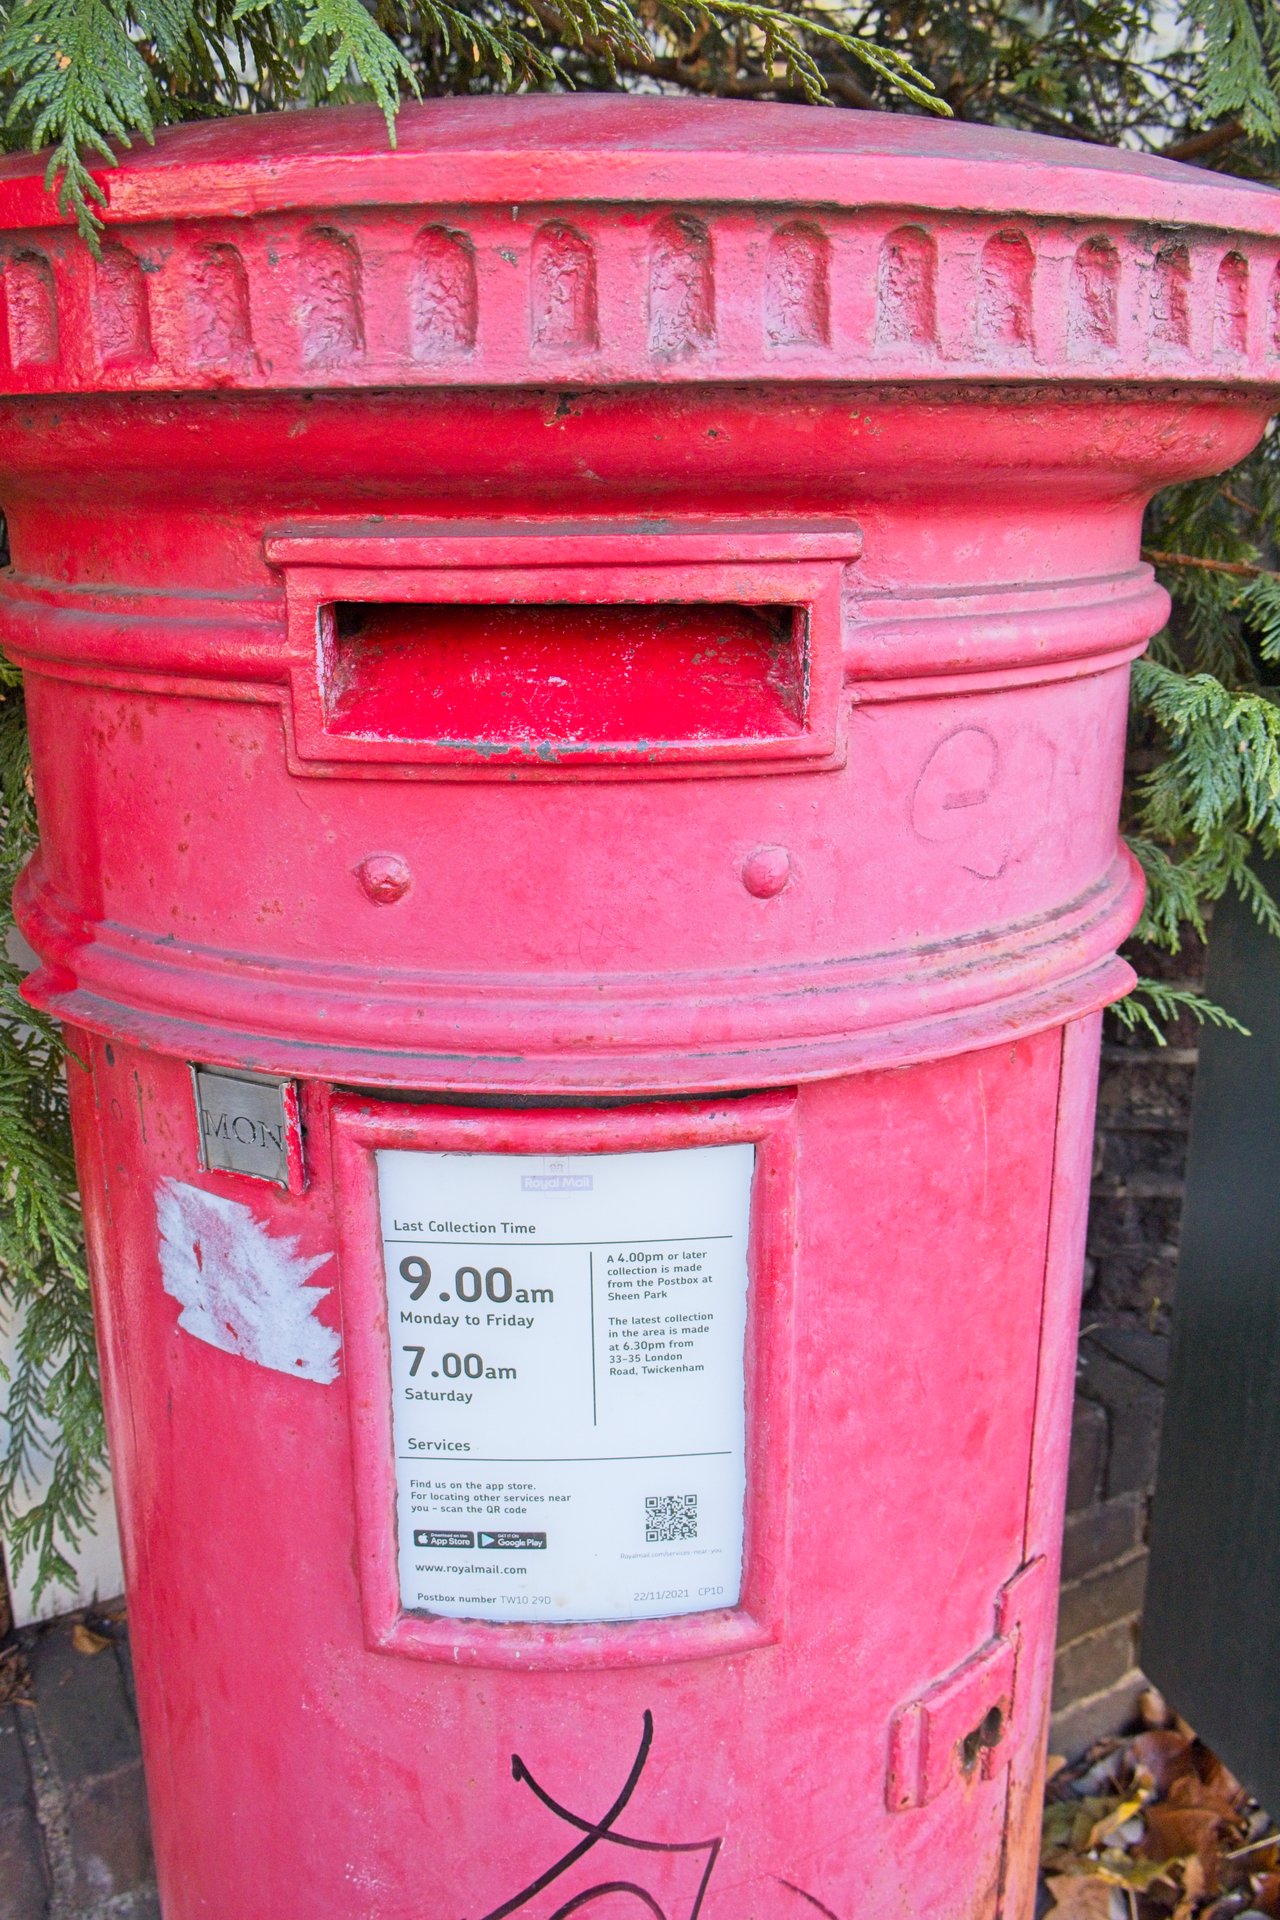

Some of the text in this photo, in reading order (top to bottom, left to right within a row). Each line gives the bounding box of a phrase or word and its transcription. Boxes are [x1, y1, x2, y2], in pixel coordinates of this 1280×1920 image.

[202, 1110, 283, 1151] MON
[525, 1177, 589, 1189] Royal Mail
[394, 1220, 536, 1234] Last Collection Time
[607, 1255, 614, 1263] A
[618, 1252, 663, 1263] 4.00pm
[683, 1251, 707, 1260] later
[608, 1264, 702, 1276] collection is made
[399, 1256, 554, 1303] 9.00am
[608, 1280, 632, 1288] from
[658, 1276, 698, 1286] Postbox
[702, 1275, 712, 1283] at
[608, 1291, 667, 1301] Sheen Park
[400, 1312, 534, 1328] Monday to Friday
[632, 1316, 661, 1325] latest
[665, 1313, 713, 1323] collection
[609, 1330, 618, 1338] in
[622, 1329, 638, 1337] the
[643, 1328, 665, 1336] area
[682, 1325, 709, 1334] made
[609, 1340, 693, 1351] at 6.30pm from
[403, 1346, 517, 1380] 7.00am
[645, 1353, 682, 1362] London
[610, 1364, 704, 1376] Road, Twickenham
[405, 1388, 473, 1404] Saturday
[408, 1438, 471, 1451] Services
[410, 1480, 431, 1488] Find
[486, 1483, 503, 1491] app
[411, 1492, 426, 1500] For
[430, 1493, 470, 1502] locating
[504, 1494, 544, 1502] services
[487, 1506, 500, 1514] QR
[504, 1506, 527, 1514] code
[431, 1538, 447, 1546] App
[498, 1539, 543, 1547] Google Play
[415, 1564, 527, 1574] www.royalmail.com
[418, 1593, 455, 1602] Postbox
[459, 1595, 496, 1603] number
[501, 1596, 528, 1604] TW10
[634, 1589, 689, 1601] 22/11/2021
